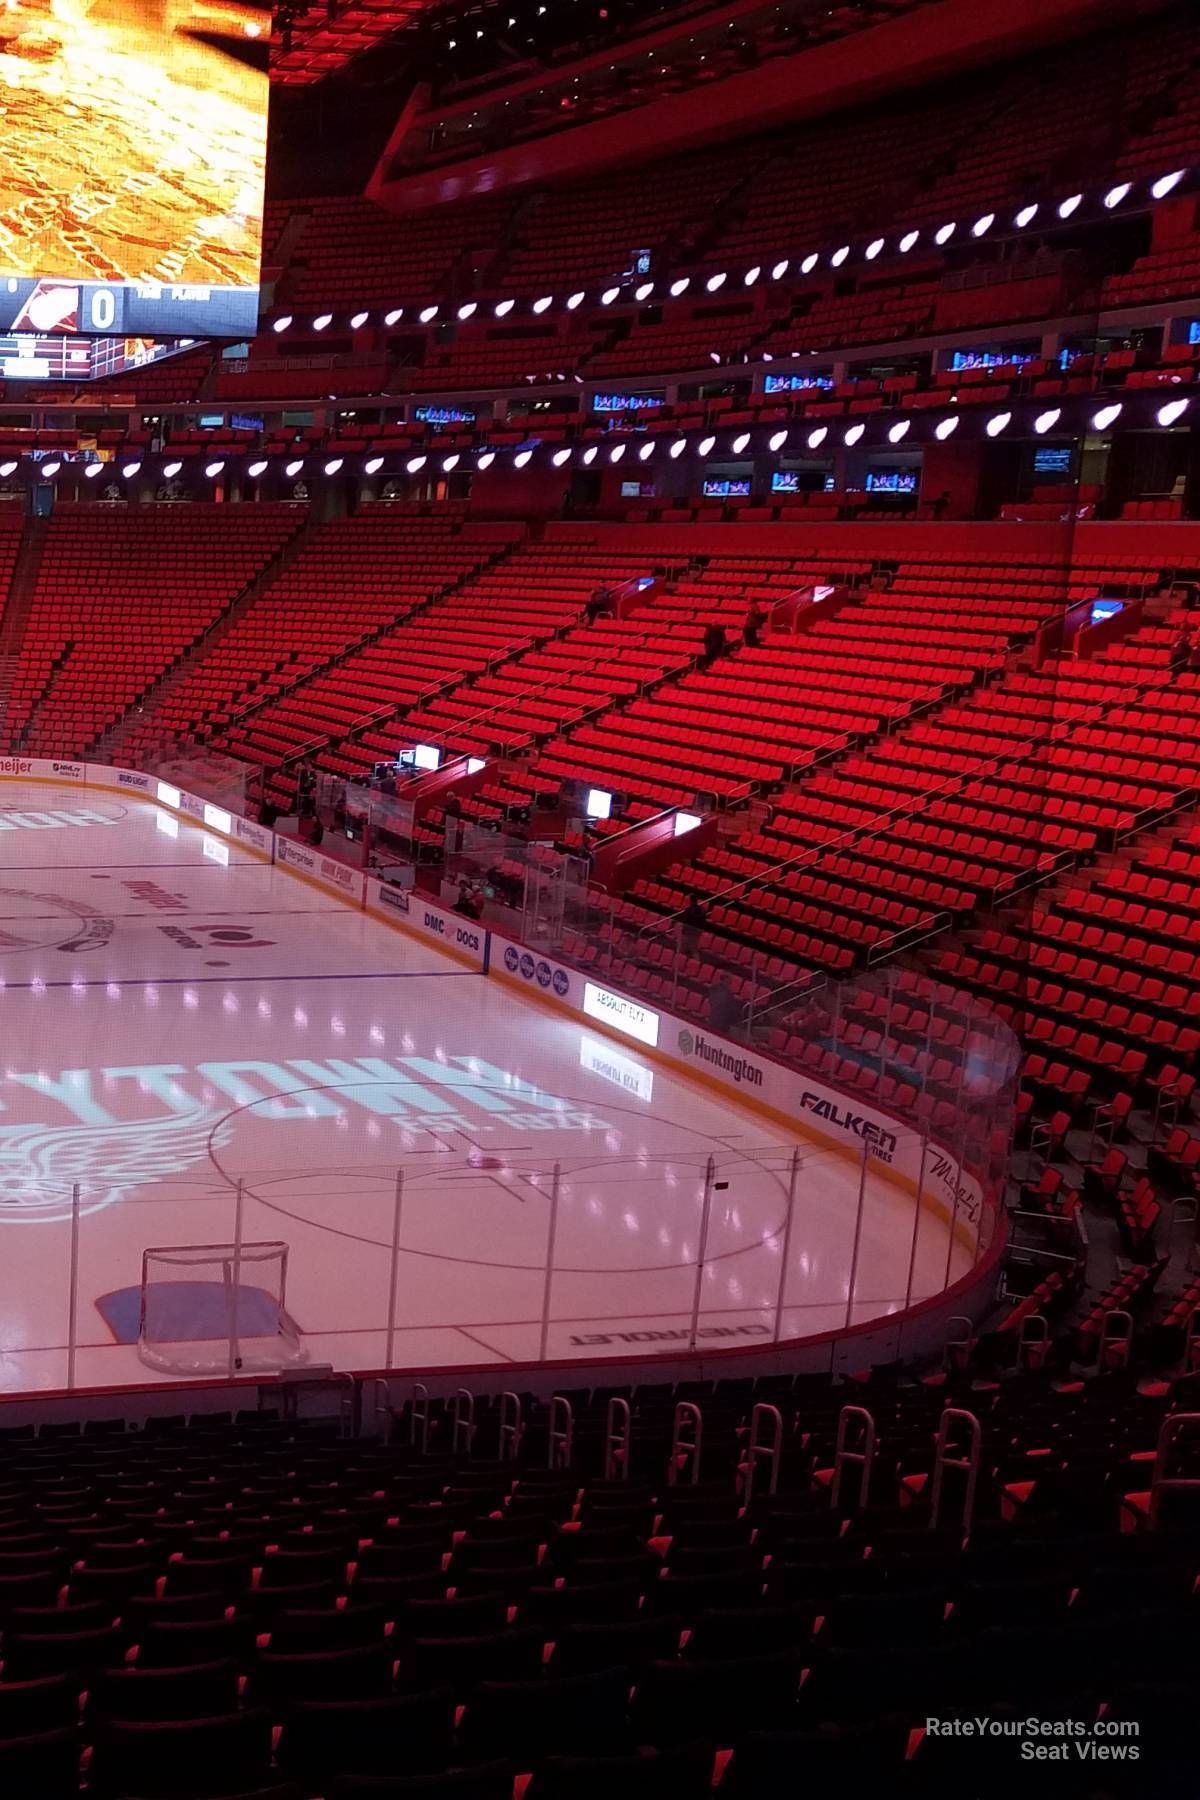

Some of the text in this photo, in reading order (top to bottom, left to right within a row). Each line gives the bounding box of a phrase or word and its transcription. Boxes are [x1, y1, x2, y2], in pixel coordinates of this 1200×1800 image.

[91, 289, 115, 329] 0
[424, 912, 479, 951] DMC DOCS
[695, 1034, 763, 1086] Huntington
[569, 1324, 772, 1346] CHEVROLET
